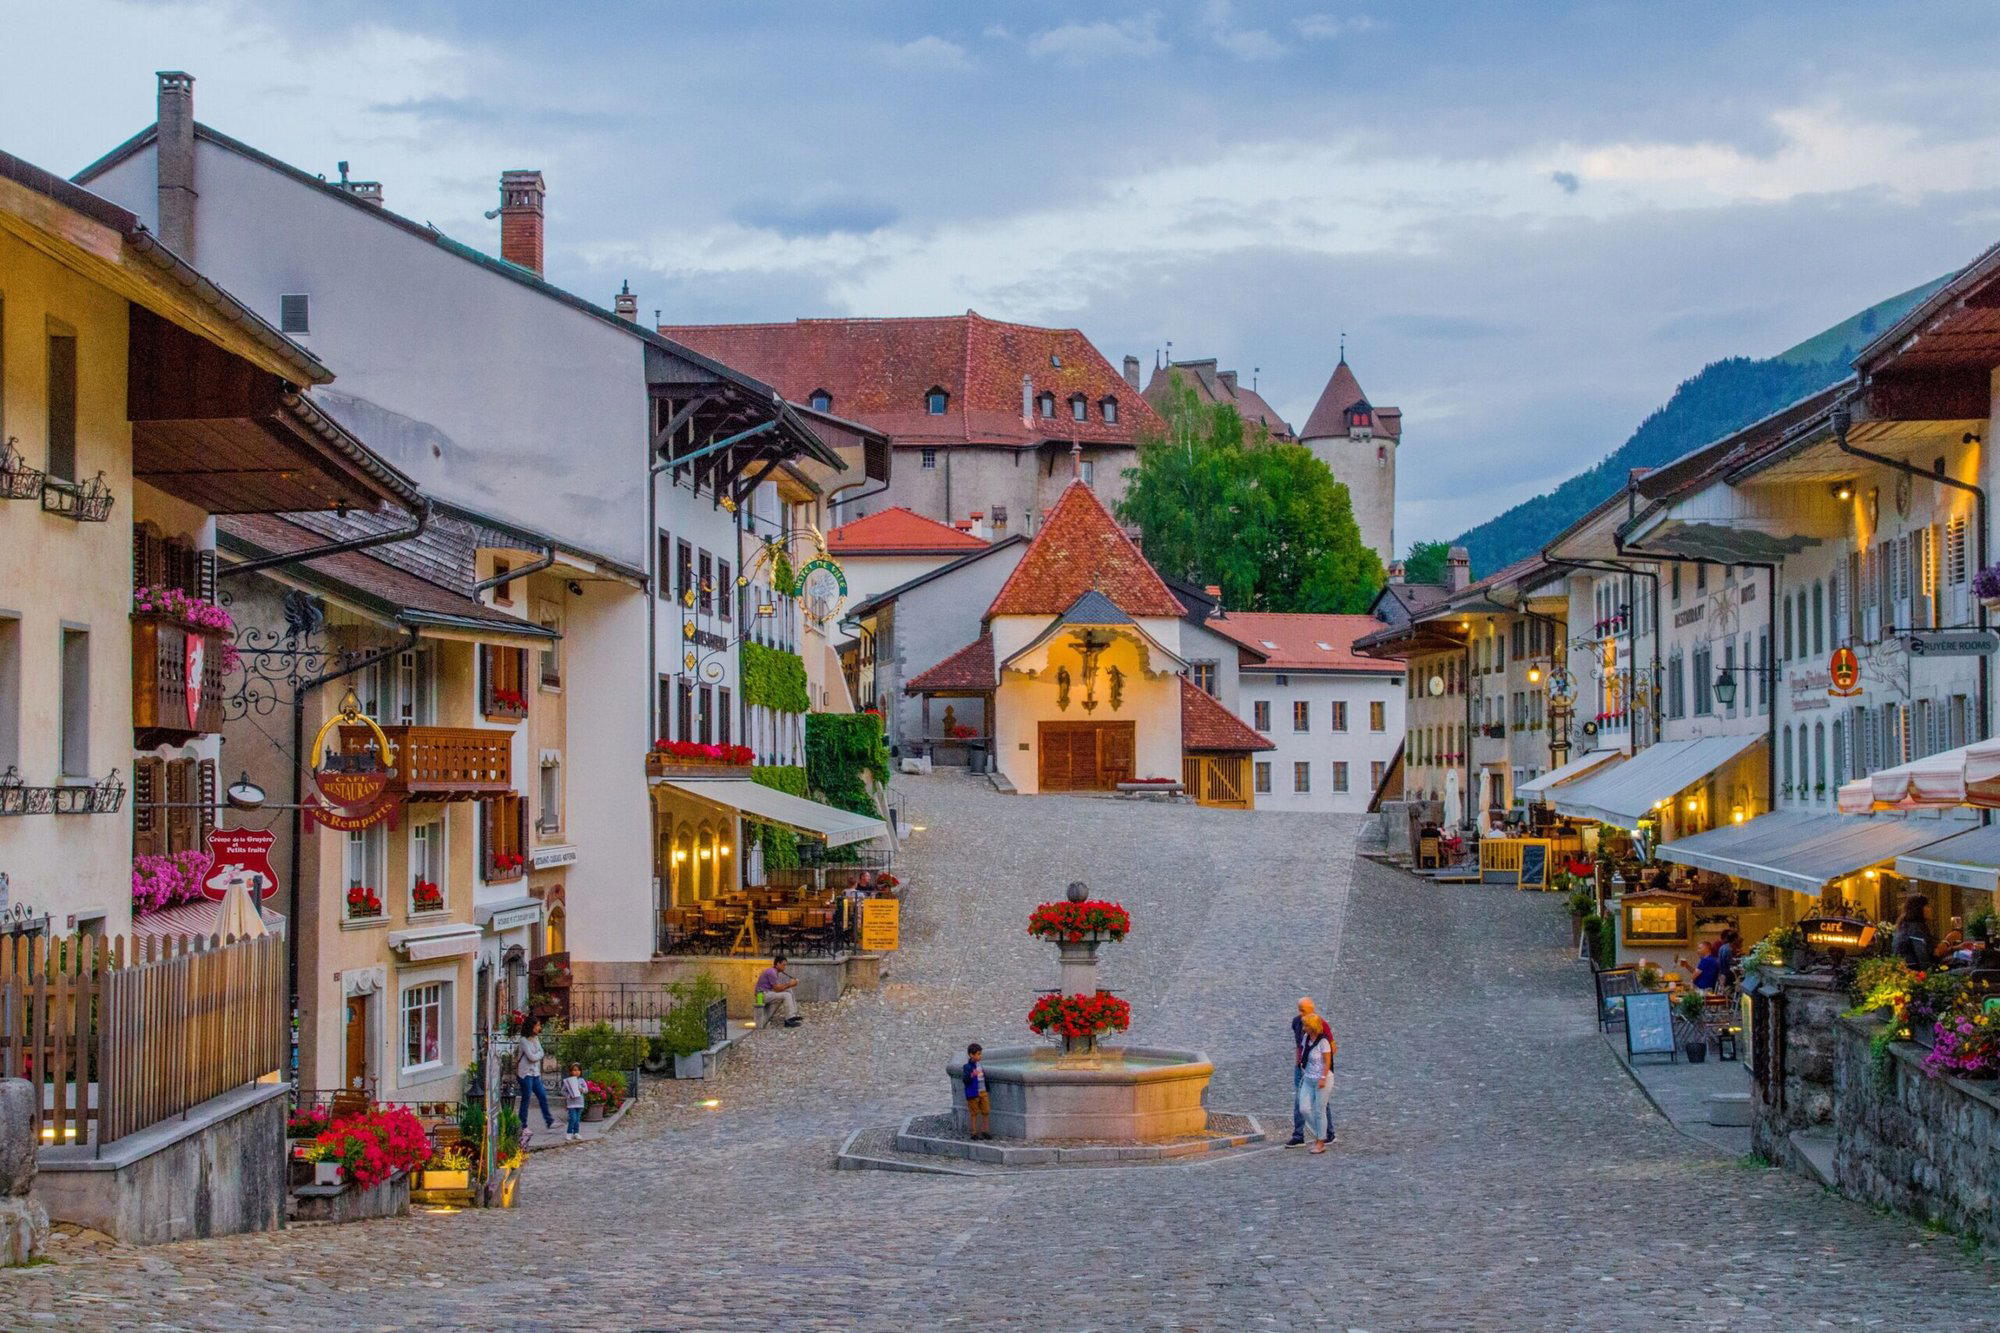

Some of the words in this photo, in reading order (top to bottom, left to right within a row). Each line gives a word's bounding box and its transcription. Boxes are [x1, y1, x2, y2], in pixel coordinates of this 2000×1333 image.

[1959, 641, 1991, 651] ROOMS
[323, 782, 380, 801] RESTAURANT
[330, 801, 393, 828] Remparts
[1820, 921, 1843, 932] CAFÉ
